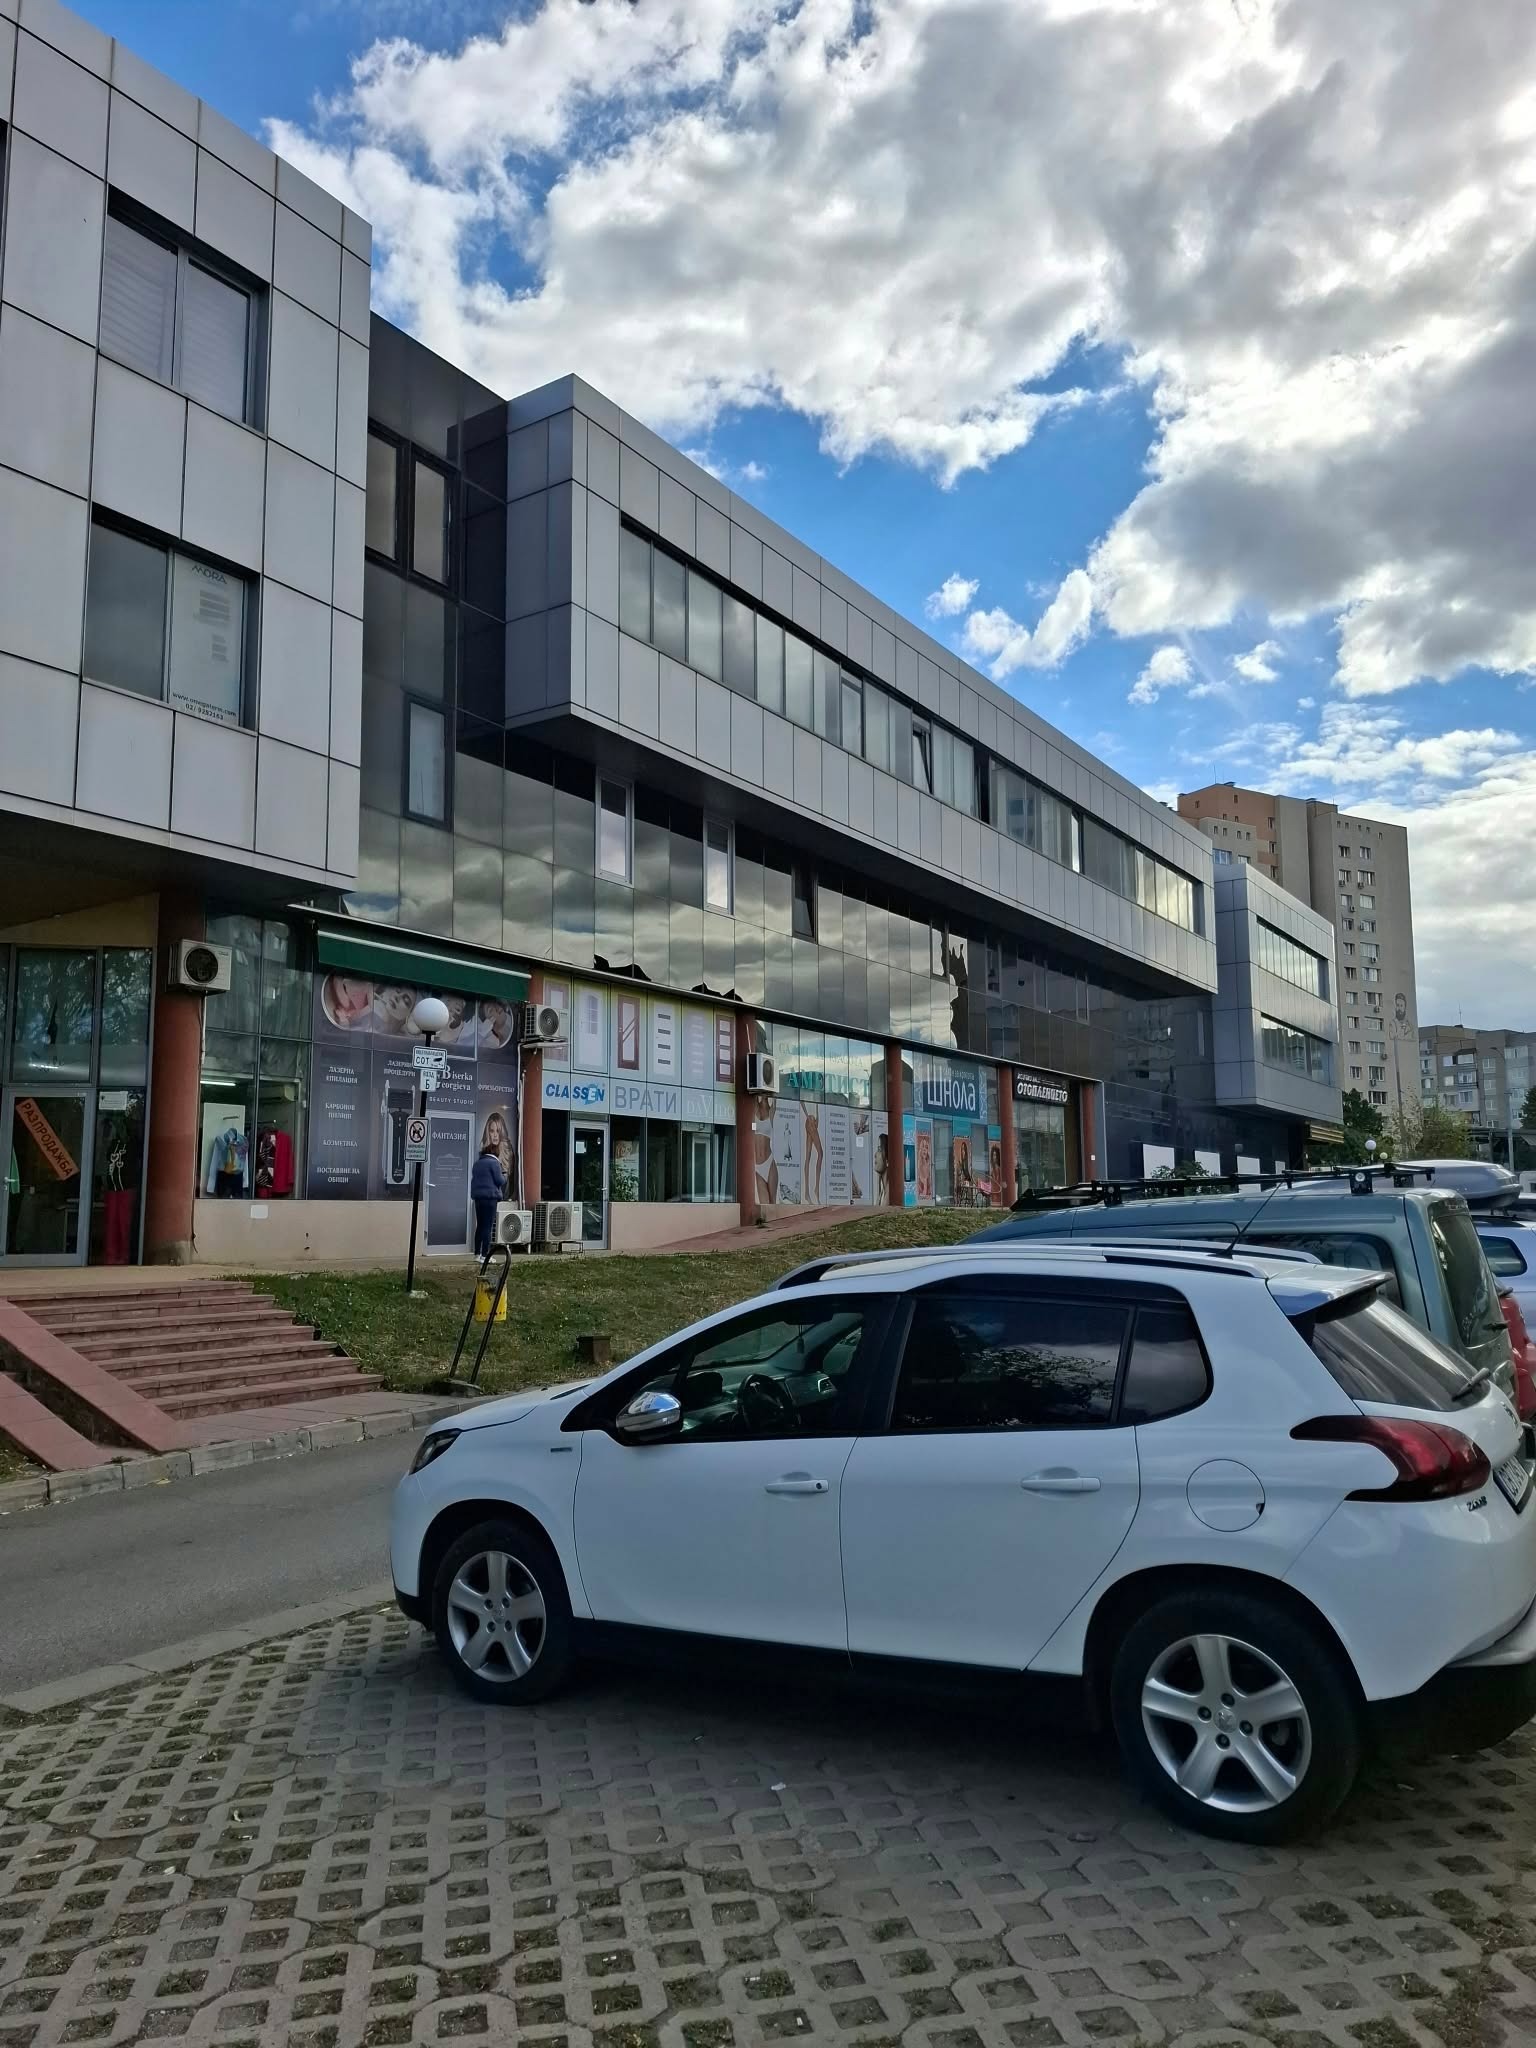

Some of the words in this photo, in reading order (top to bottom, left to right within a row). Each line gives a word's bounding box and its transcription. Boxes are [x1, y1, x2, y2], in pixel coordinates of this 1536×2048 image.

[191, 565, 227, 584] MORA
[328, 1066, 354, 1075] ЛАЗЕРНА
[545, 1083, 605, 1102] CLASSEN
[787, 1070, 870, 1098] АМЕТИСТ
[927, 1063, 976, 1111] Шнола
[1017, 1082, 1068, 1102] ОТОПЛЕНИЕТО
[615, 1086, 677, 1113] ВРАТИ
[21, 1102, 73, 1176] РАЗПРОДАЖБА
[323, 1139, 358, 1147] КОЗМЕТИКА
[432, 1131, 467, 1140] ФАНТАЗИЯ
